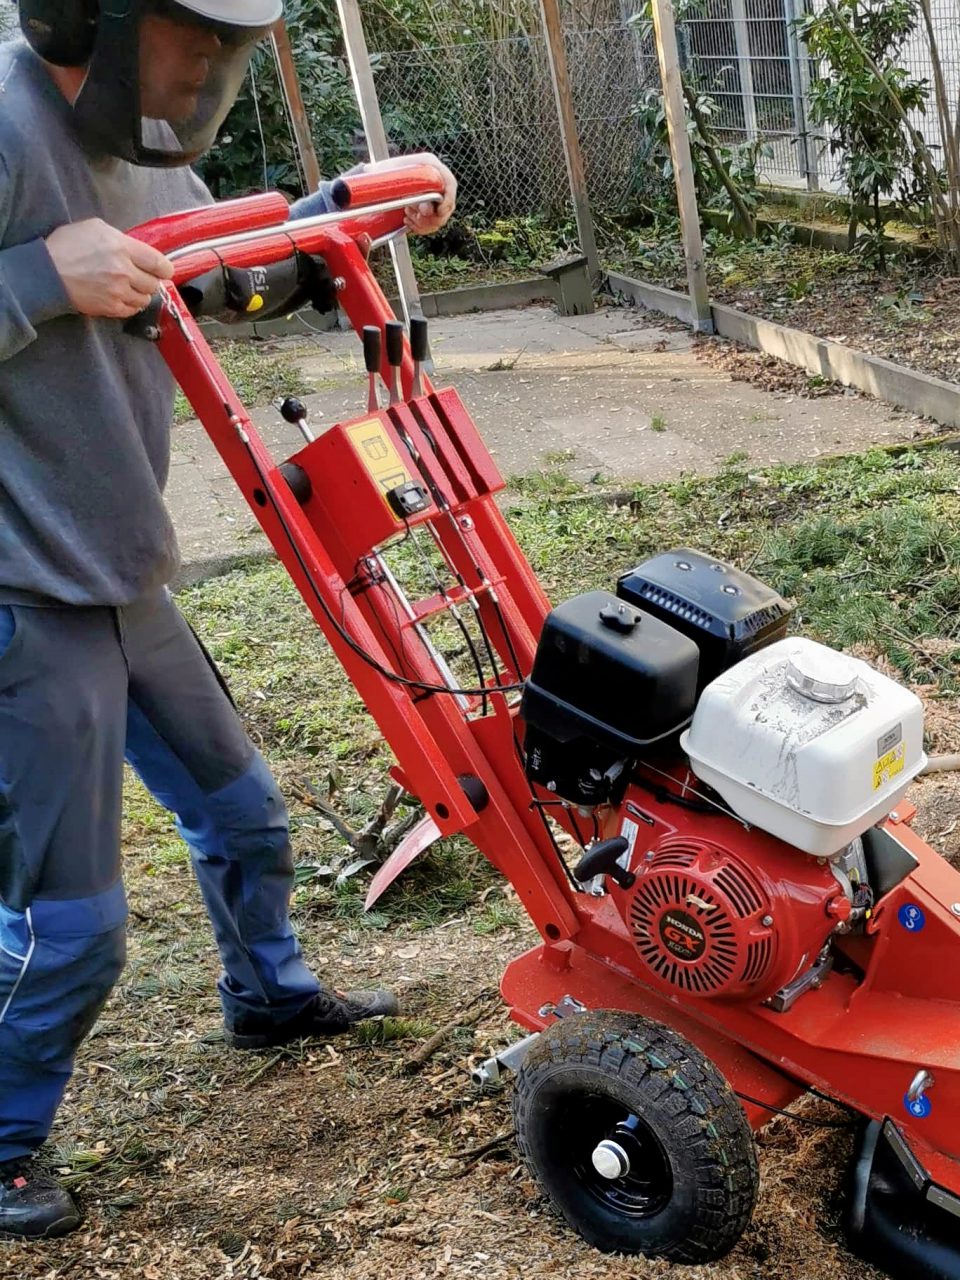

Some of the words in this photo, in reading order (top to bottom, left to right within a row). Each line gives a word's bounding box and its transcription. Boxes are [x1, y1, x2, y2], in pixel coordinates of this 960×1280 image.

[250, 266, 269, 291] fsi
[664, 926, 700, 951] GX
[666, 915, 704, 940] HONDA
